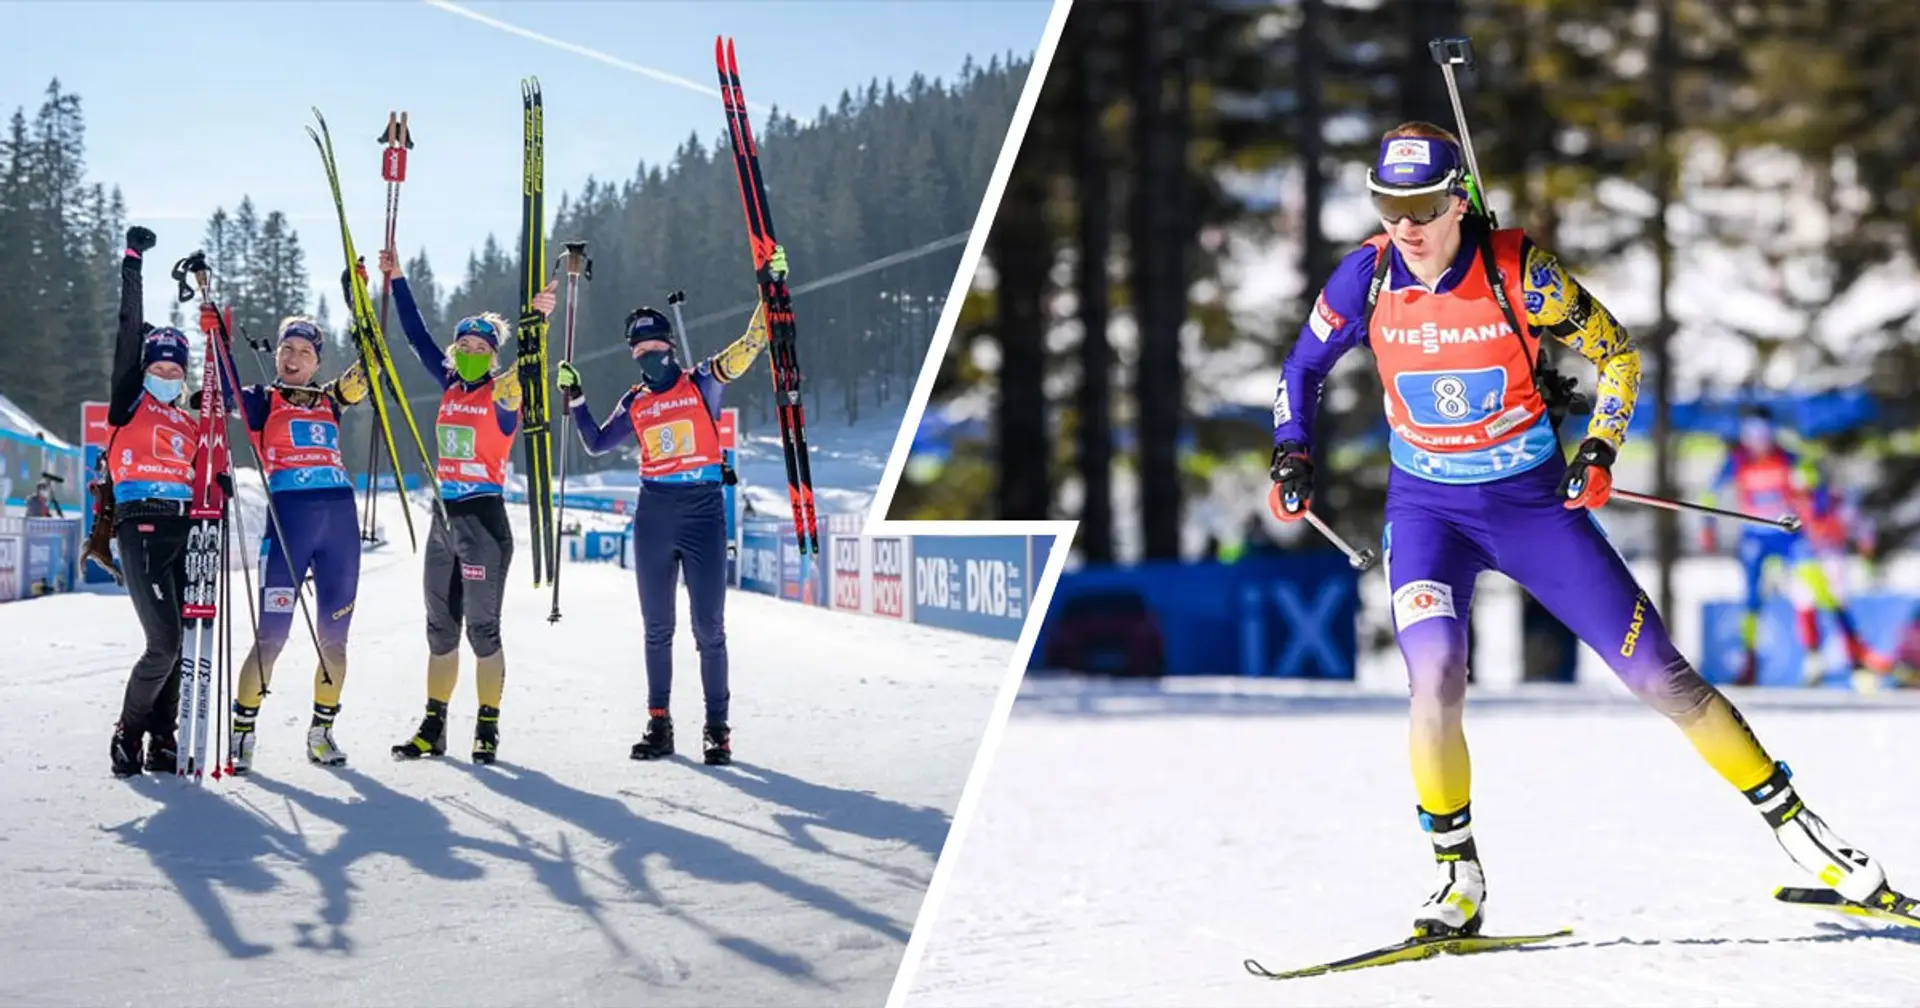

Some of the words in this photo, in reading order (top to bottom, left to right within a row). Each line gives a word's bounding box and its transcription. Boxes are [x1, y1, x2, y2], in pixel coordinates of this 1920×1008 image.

[1432, 376, 1470, 420] 8
[309, 423, 326, 445] 8
[446, 428, 458, 454] 8
[660, 427, 676, 454] 8
[915, 557, 949, 609] DKB
[966, 559, 1007, 616] DKB
[1245, 576, 1347, 679] iX
[1620, 601, 1646, 658] CRAFT
